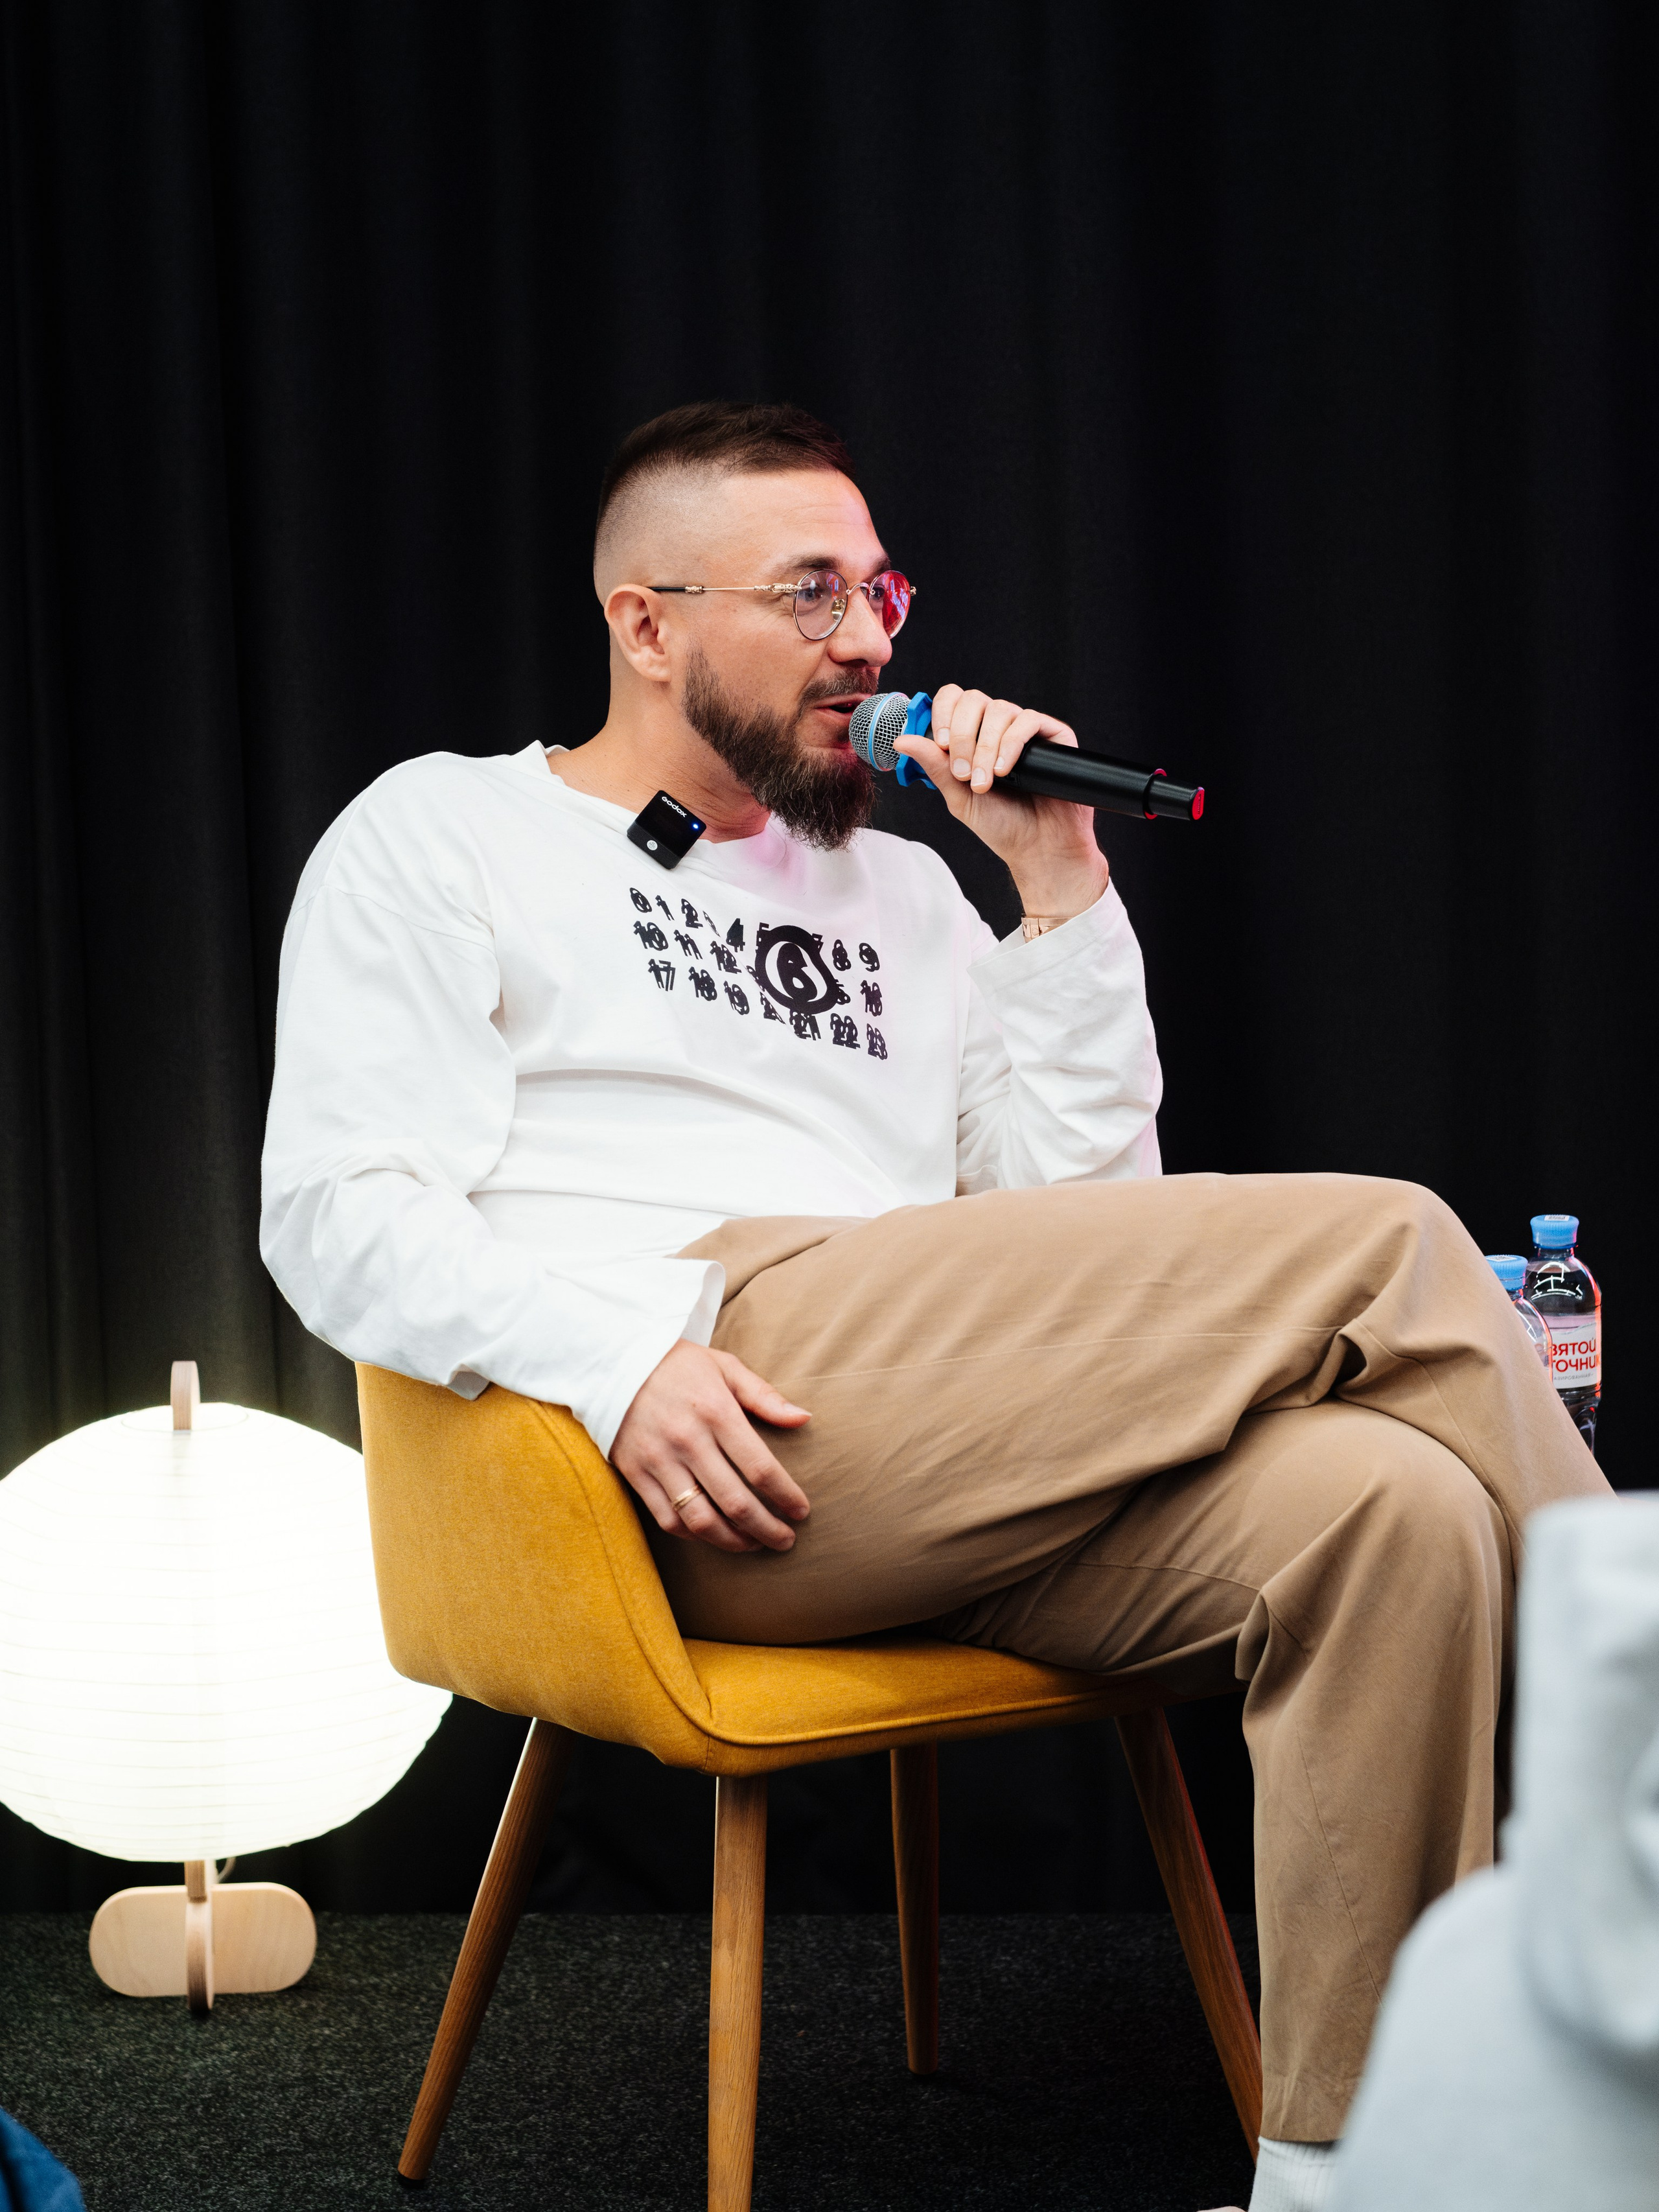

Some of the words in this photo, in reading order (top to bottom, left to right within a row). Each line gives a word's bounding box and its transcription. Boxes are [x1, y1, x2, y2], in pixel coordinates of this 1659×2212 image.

[662, 796, 687, 818] Godox
[655, 895, 675, 921] 1
[831, 939, 852, 972] 8
[648, 959, 676, 992] 17
